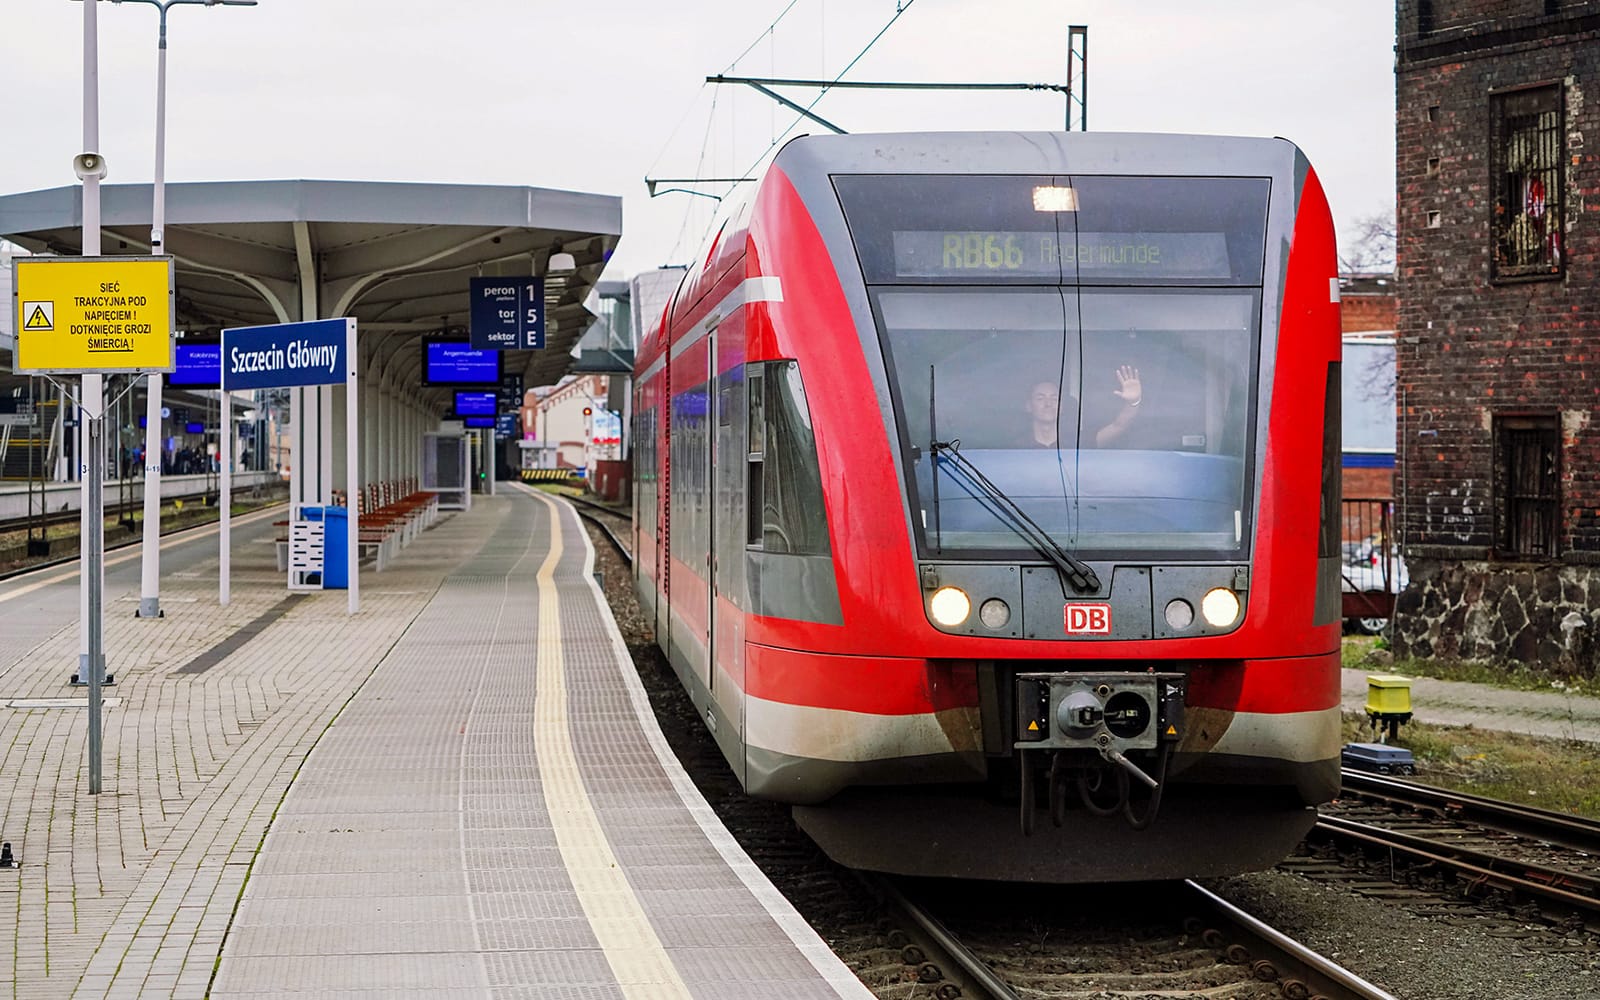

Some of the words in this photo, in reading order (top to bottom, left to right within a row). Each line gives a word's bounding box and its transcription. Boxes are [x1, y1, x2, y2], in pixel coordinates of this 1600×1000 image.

[942, 234, 1023, 269] RB66
[99, 280, 121, 293] SIEĆ
[483, 287, 516, 298] peron
[526, 284, 535, 302] 1
[73, 296, 126, 307] TRAKCYJNA
[127, 296, 147, 306] POD
[84, 310, 132, 323] NAPIĘCIEM
[498, 309, 516, 319] tor
[526, 308, 538, 324] 5
[70, 324, 122, 336] DOTKNIĘCIE
[124, 324, 152, 334] GROZI
[487, 331, 516, 341] sektor
[527, 330, 538, 346] E
[231, 343, 285, 374] Szczecin
[286, 339, 338, 374] Główny
[1070, 608, 1106, 630] DB
